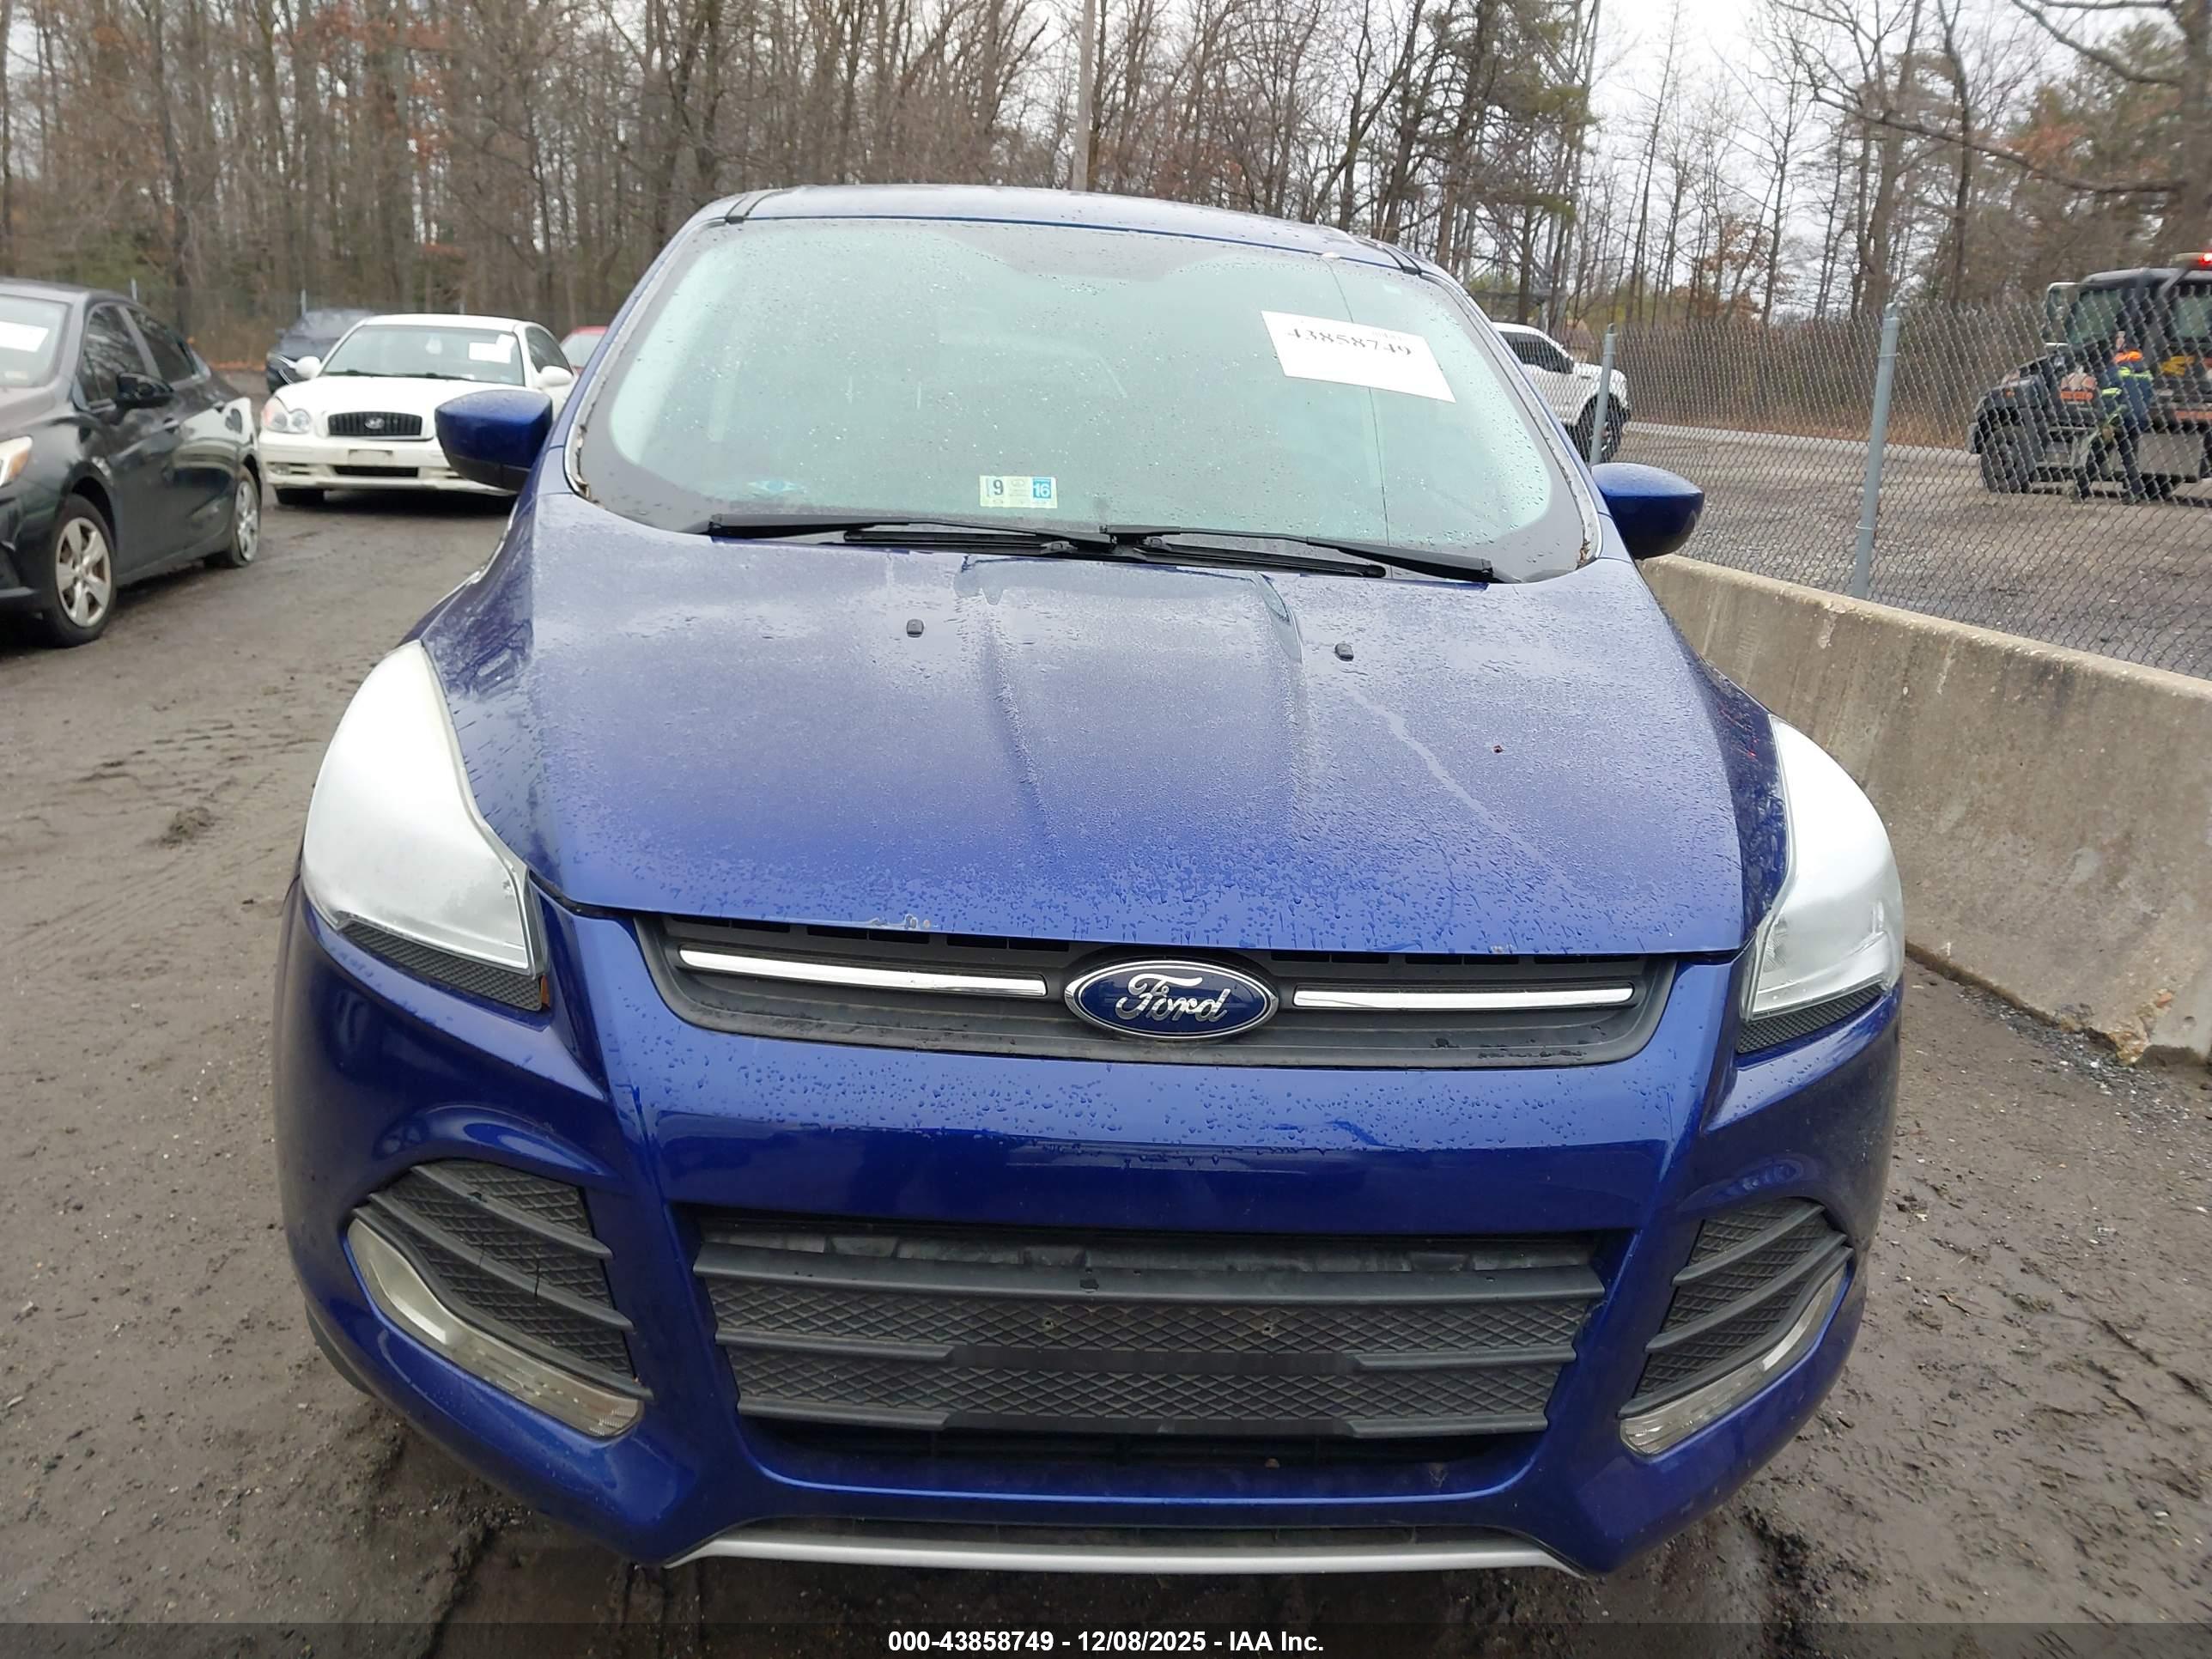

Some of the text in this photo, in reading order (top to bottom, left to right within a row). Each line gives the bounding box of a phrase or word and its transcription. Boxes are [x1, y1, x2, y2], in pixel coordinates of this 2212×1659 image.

[1288, 328, 1413, 356] 43858749
[993, 479, 1004, 495] 9
[1033, 483, 1051, 498] 16
[1115, 973, 1231, 1023] Ford
